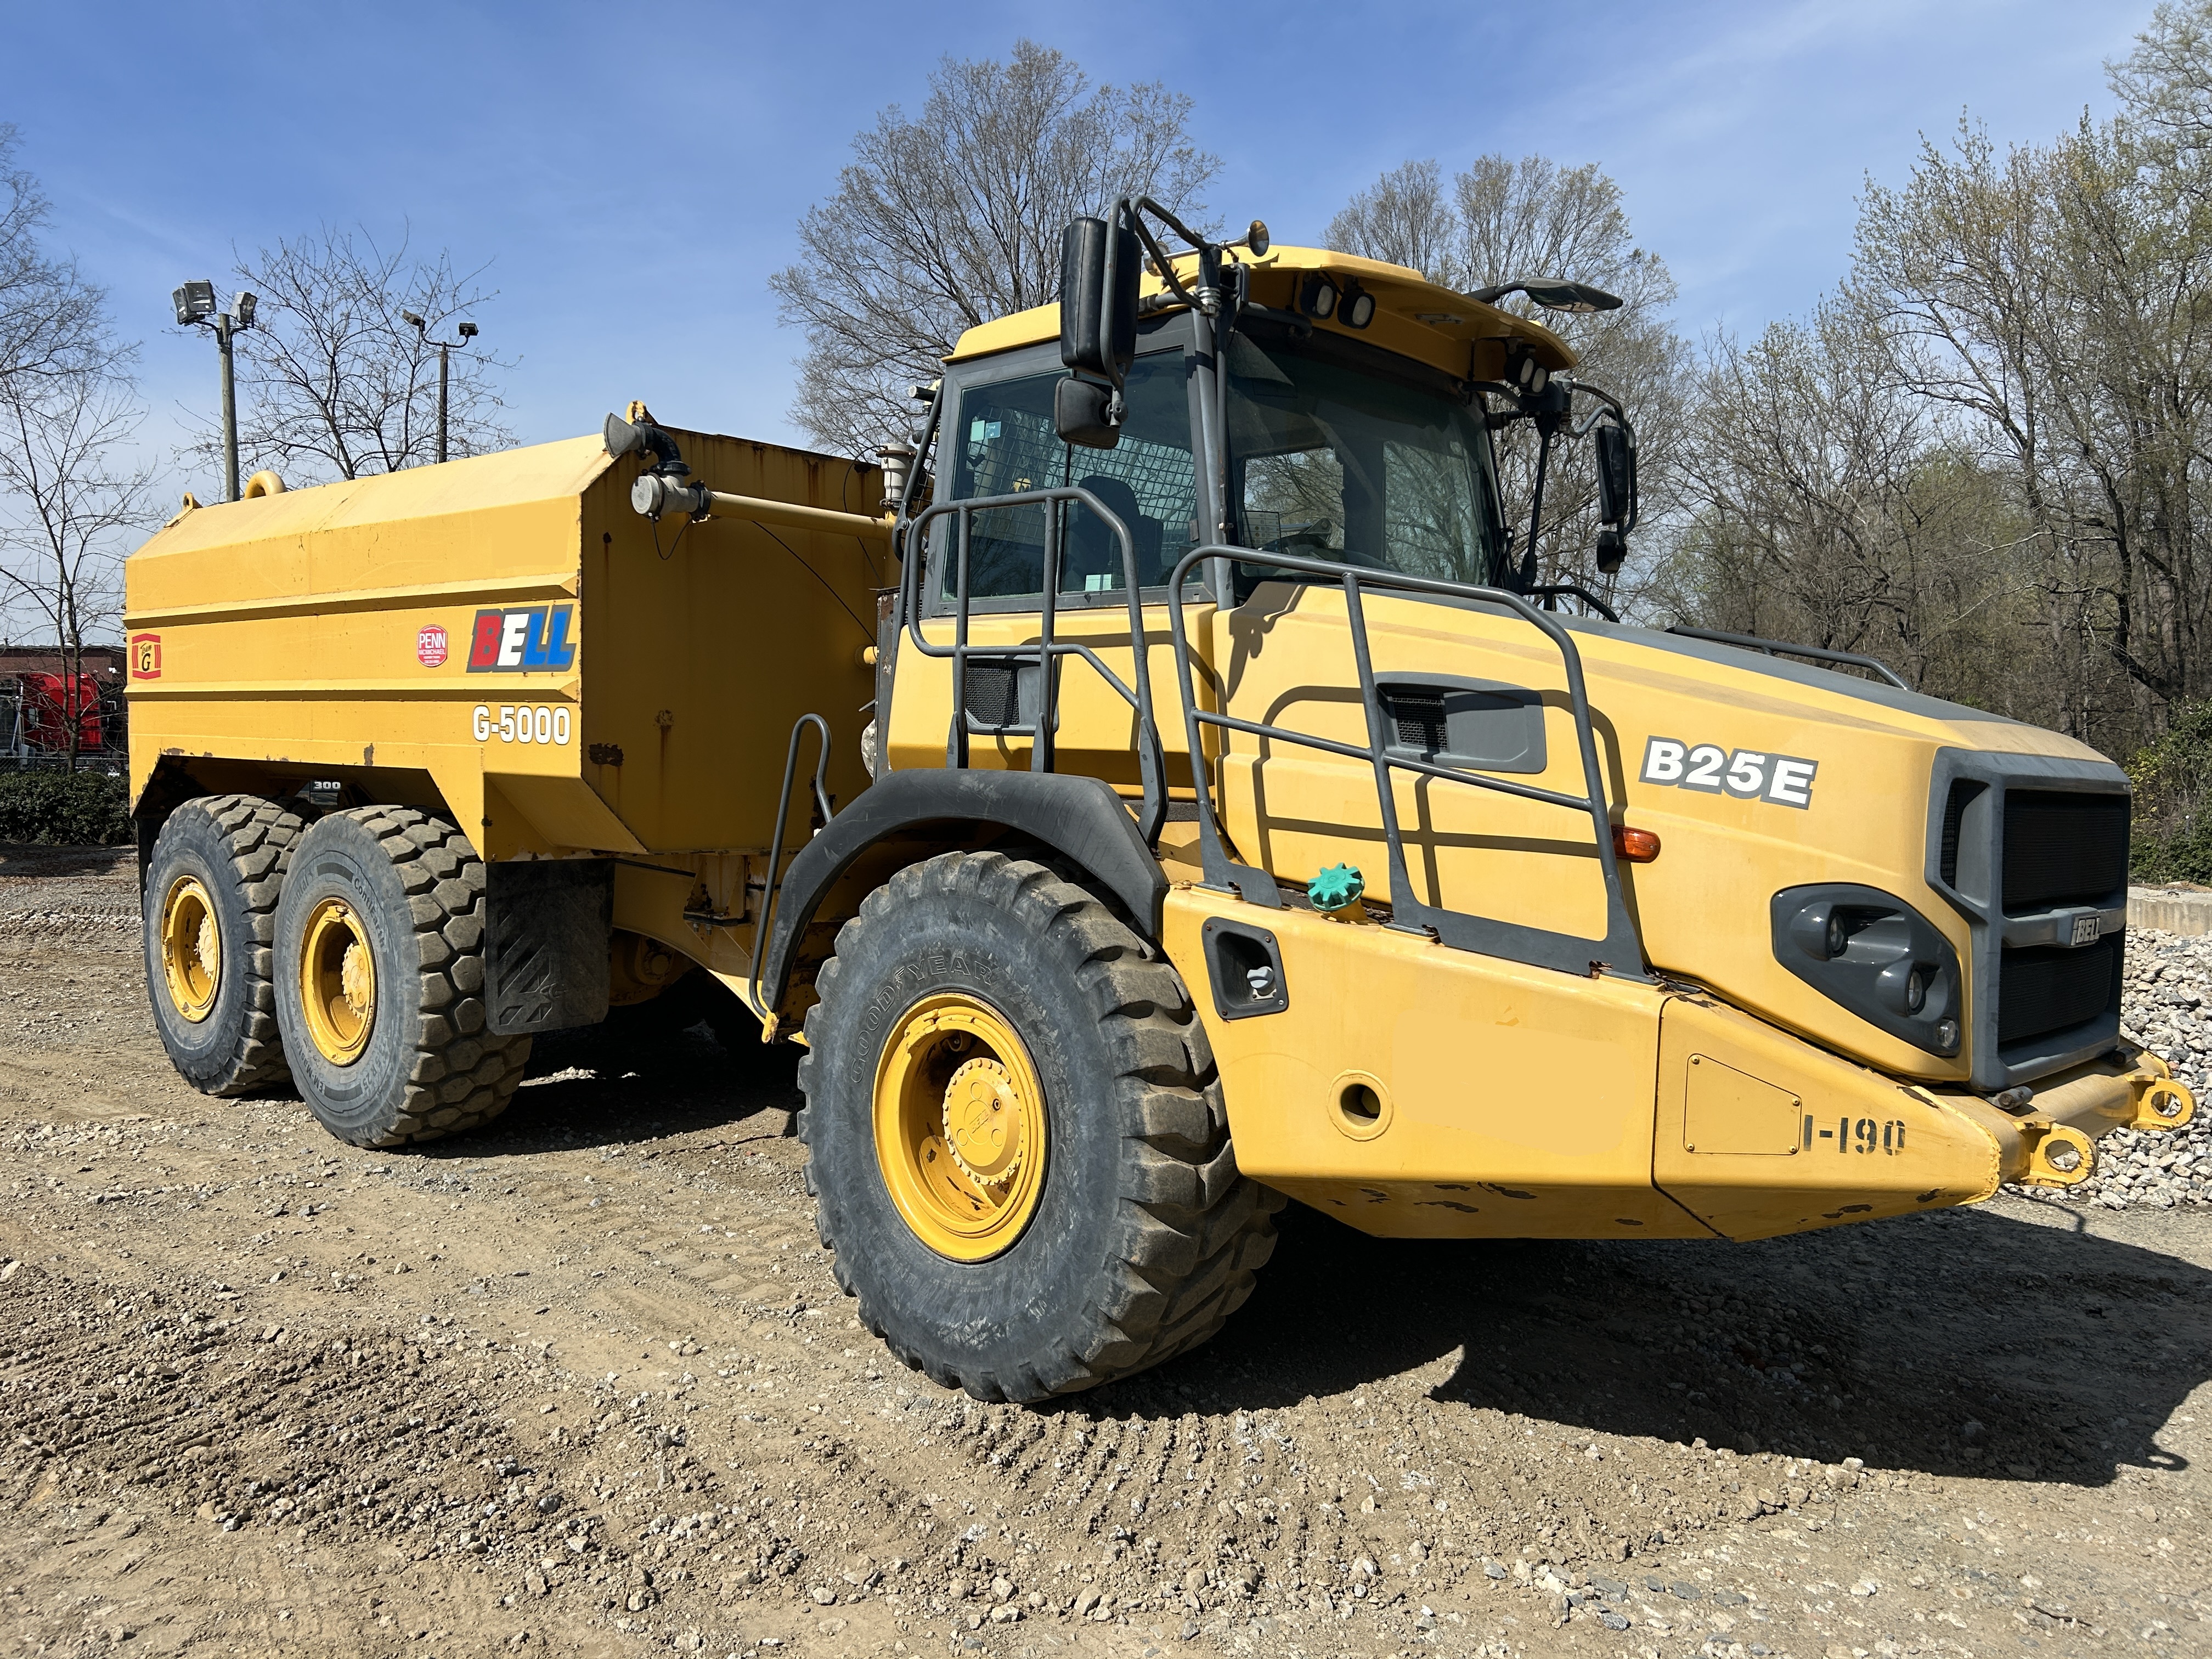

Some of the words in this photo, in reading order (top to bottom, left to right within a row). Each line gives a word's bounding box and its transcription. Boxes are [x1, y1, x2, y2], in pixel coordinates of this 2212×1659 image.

[419, 633, 445, 648] PENN
[470, 611, 572, 667] BELL
[142, 653, 151, 672] G
[473, 704, 571, 745] G-5000
[314, 781, 341, 789] 300
[1646, 740, 1814, 805] B25E
[281, 873, 309, 948] ontinental
[2076, 917, 2101, 943] BELL
[294, 1036, 324, 1093] EM-Master
